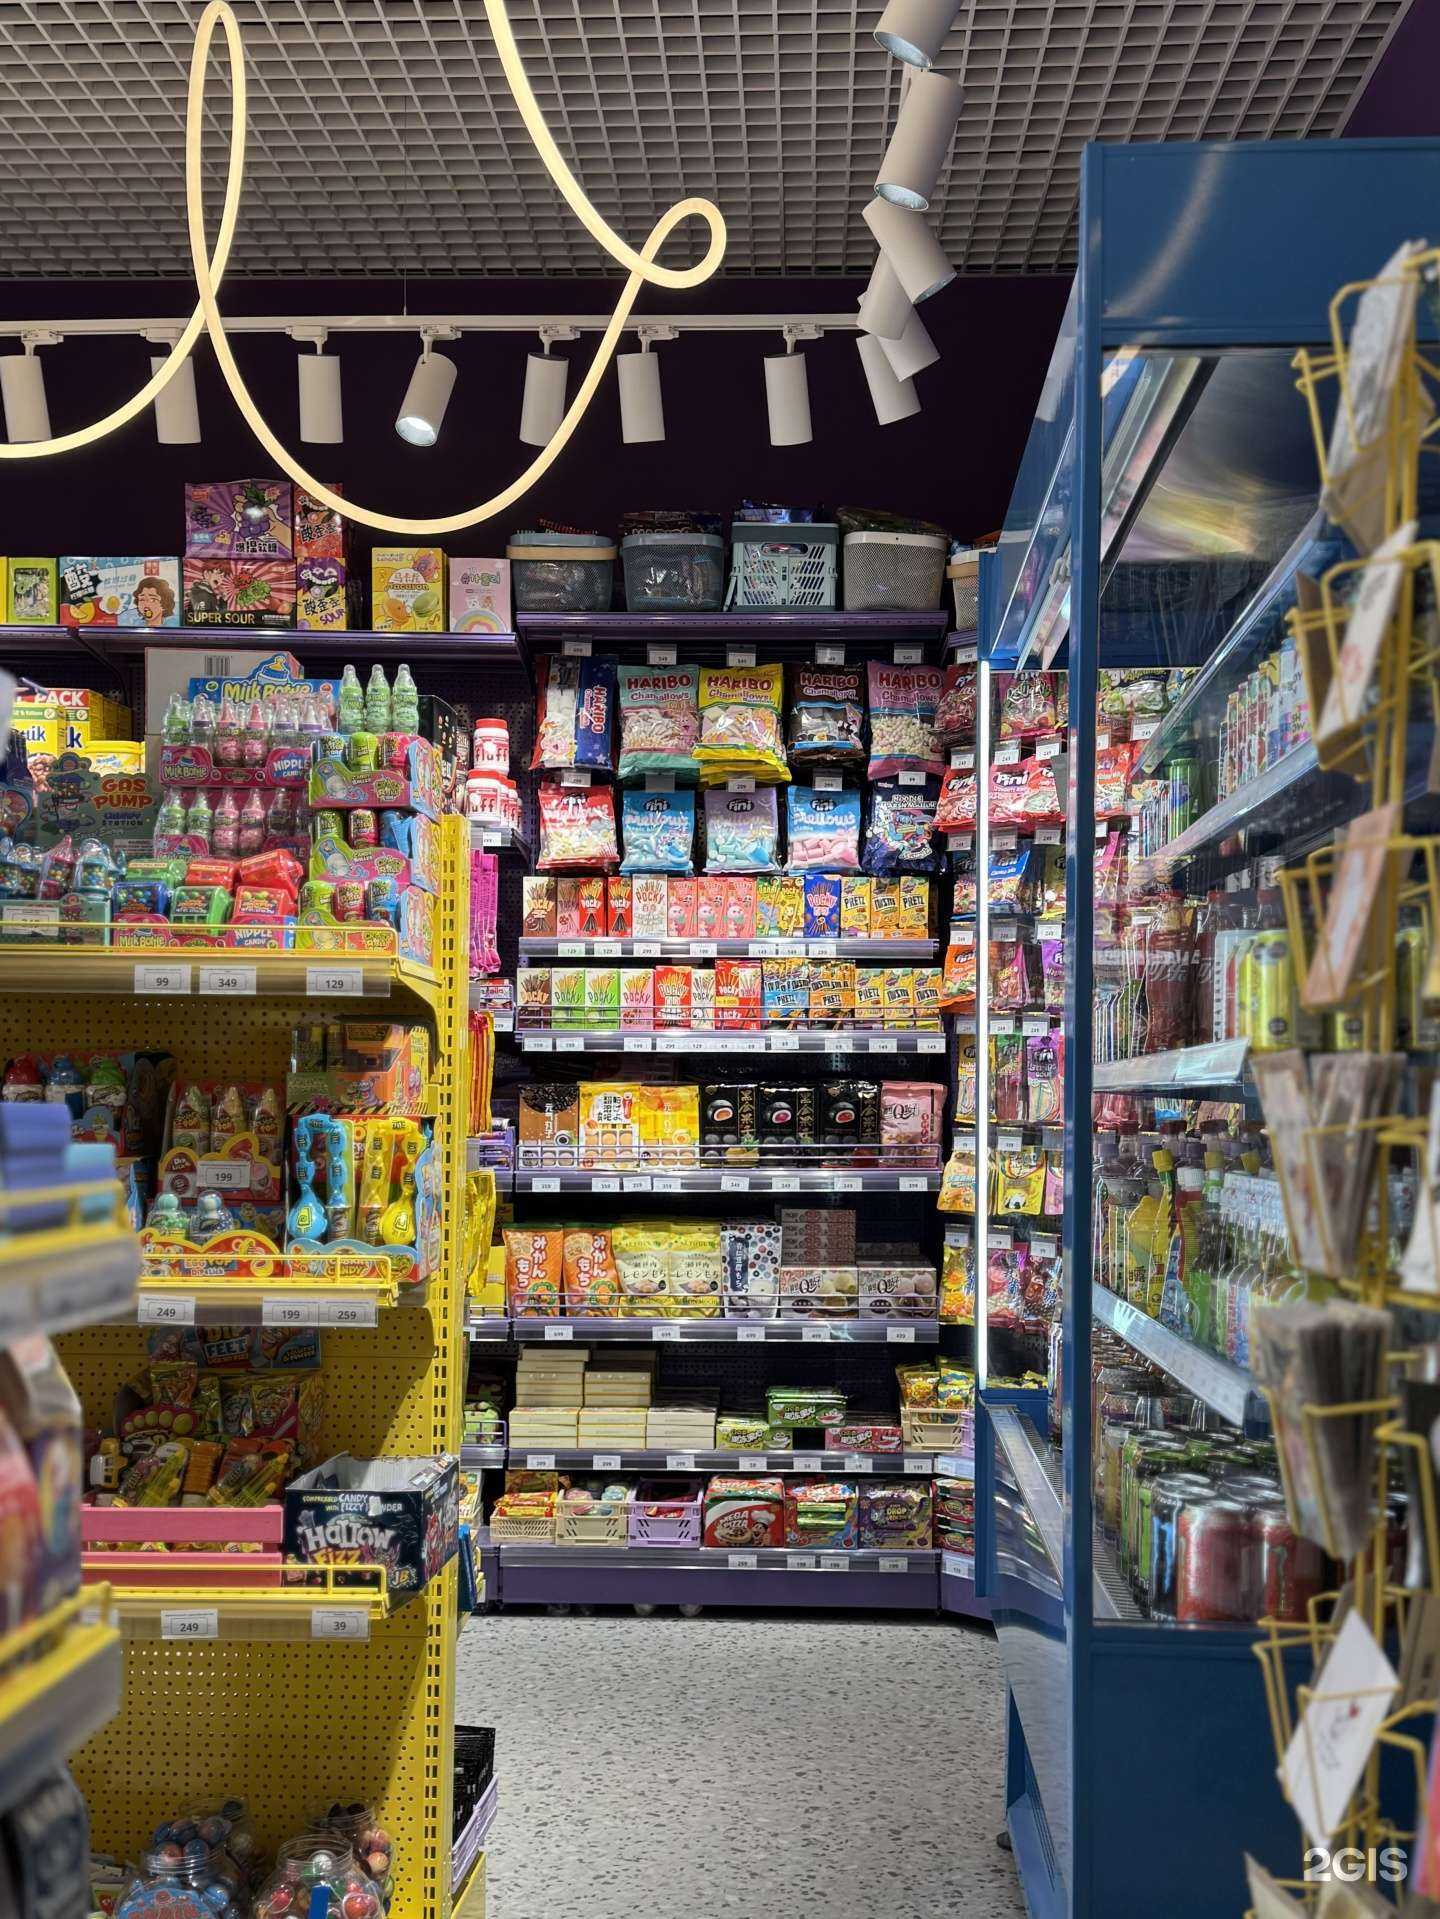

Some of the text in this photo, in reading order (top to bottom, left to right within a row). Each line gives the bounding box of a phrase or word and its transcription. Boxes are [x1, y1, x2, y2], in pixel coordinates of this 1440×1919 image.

[187, 612, 255, 624] SUPER SOUR
[626, 674, 692, 690] HARIBO
[707, 676, 773, 691] HARIBO
[800, 673, 858, 687] HARIBO
[878, 671, 942, 690] HARIBO
[223, 682, 261, 704] Milk
[630, 691, 689, 702] Chamallows
[593, 687, 607, 733] HARIBO
[273, 759, 311, 771] NIPPLE
[164, 766, 182, 778] Milk
[996, 772, 1029, 785] Fini
[102, 778, 146, 793] GAS
[92, 793, 153, 810] PUMP
[728, 800, 753, 811] Fini
[635, 891, 665, 904] POCKY
[844, 896, 865, 908] PRETZ
[234, 928, 273, 938] NIPPLE
[120, 935, 139, 947] Milk
[155, 977, 169, 986] 99
[218, 977, 238, 988] 349
[325, 979, 344, 989] 129
[555, 991, 581, 1003] POCKY
[587, 991, 615, 1003] POCKY
[623, 991, 650, 1003] POCKY
[693, 992, 713, 1002] POCKY
[857, 988, 880, 1000] PRETZ
[215, 1173, 232, 1181] 199
[531, 1235, 548, 1279] みかん
[592, 1235, 608, 1278] みかん
[516, 1258, 531, 1288] もち
[577, 1257, 592, 1287] もち
[156, 1308, 176, 1318] 249
[282, 1310, 300, 1320] 199
[338, 1310, 357, 1320] 259
[205, 1337, 248, 1357] FEET
[338, 1494, 368, 1503] CANDY
[341, 1503, 365, 1512] FIZZY
[886, 1506, 906, 1516] DROP
[719, 1510, 749, 1525] MEGA
[722, 1519, 748, 1529] PIZZA
[180, 1622, 199, 1633] 249
[333, 1621, 347, 1632] 39
